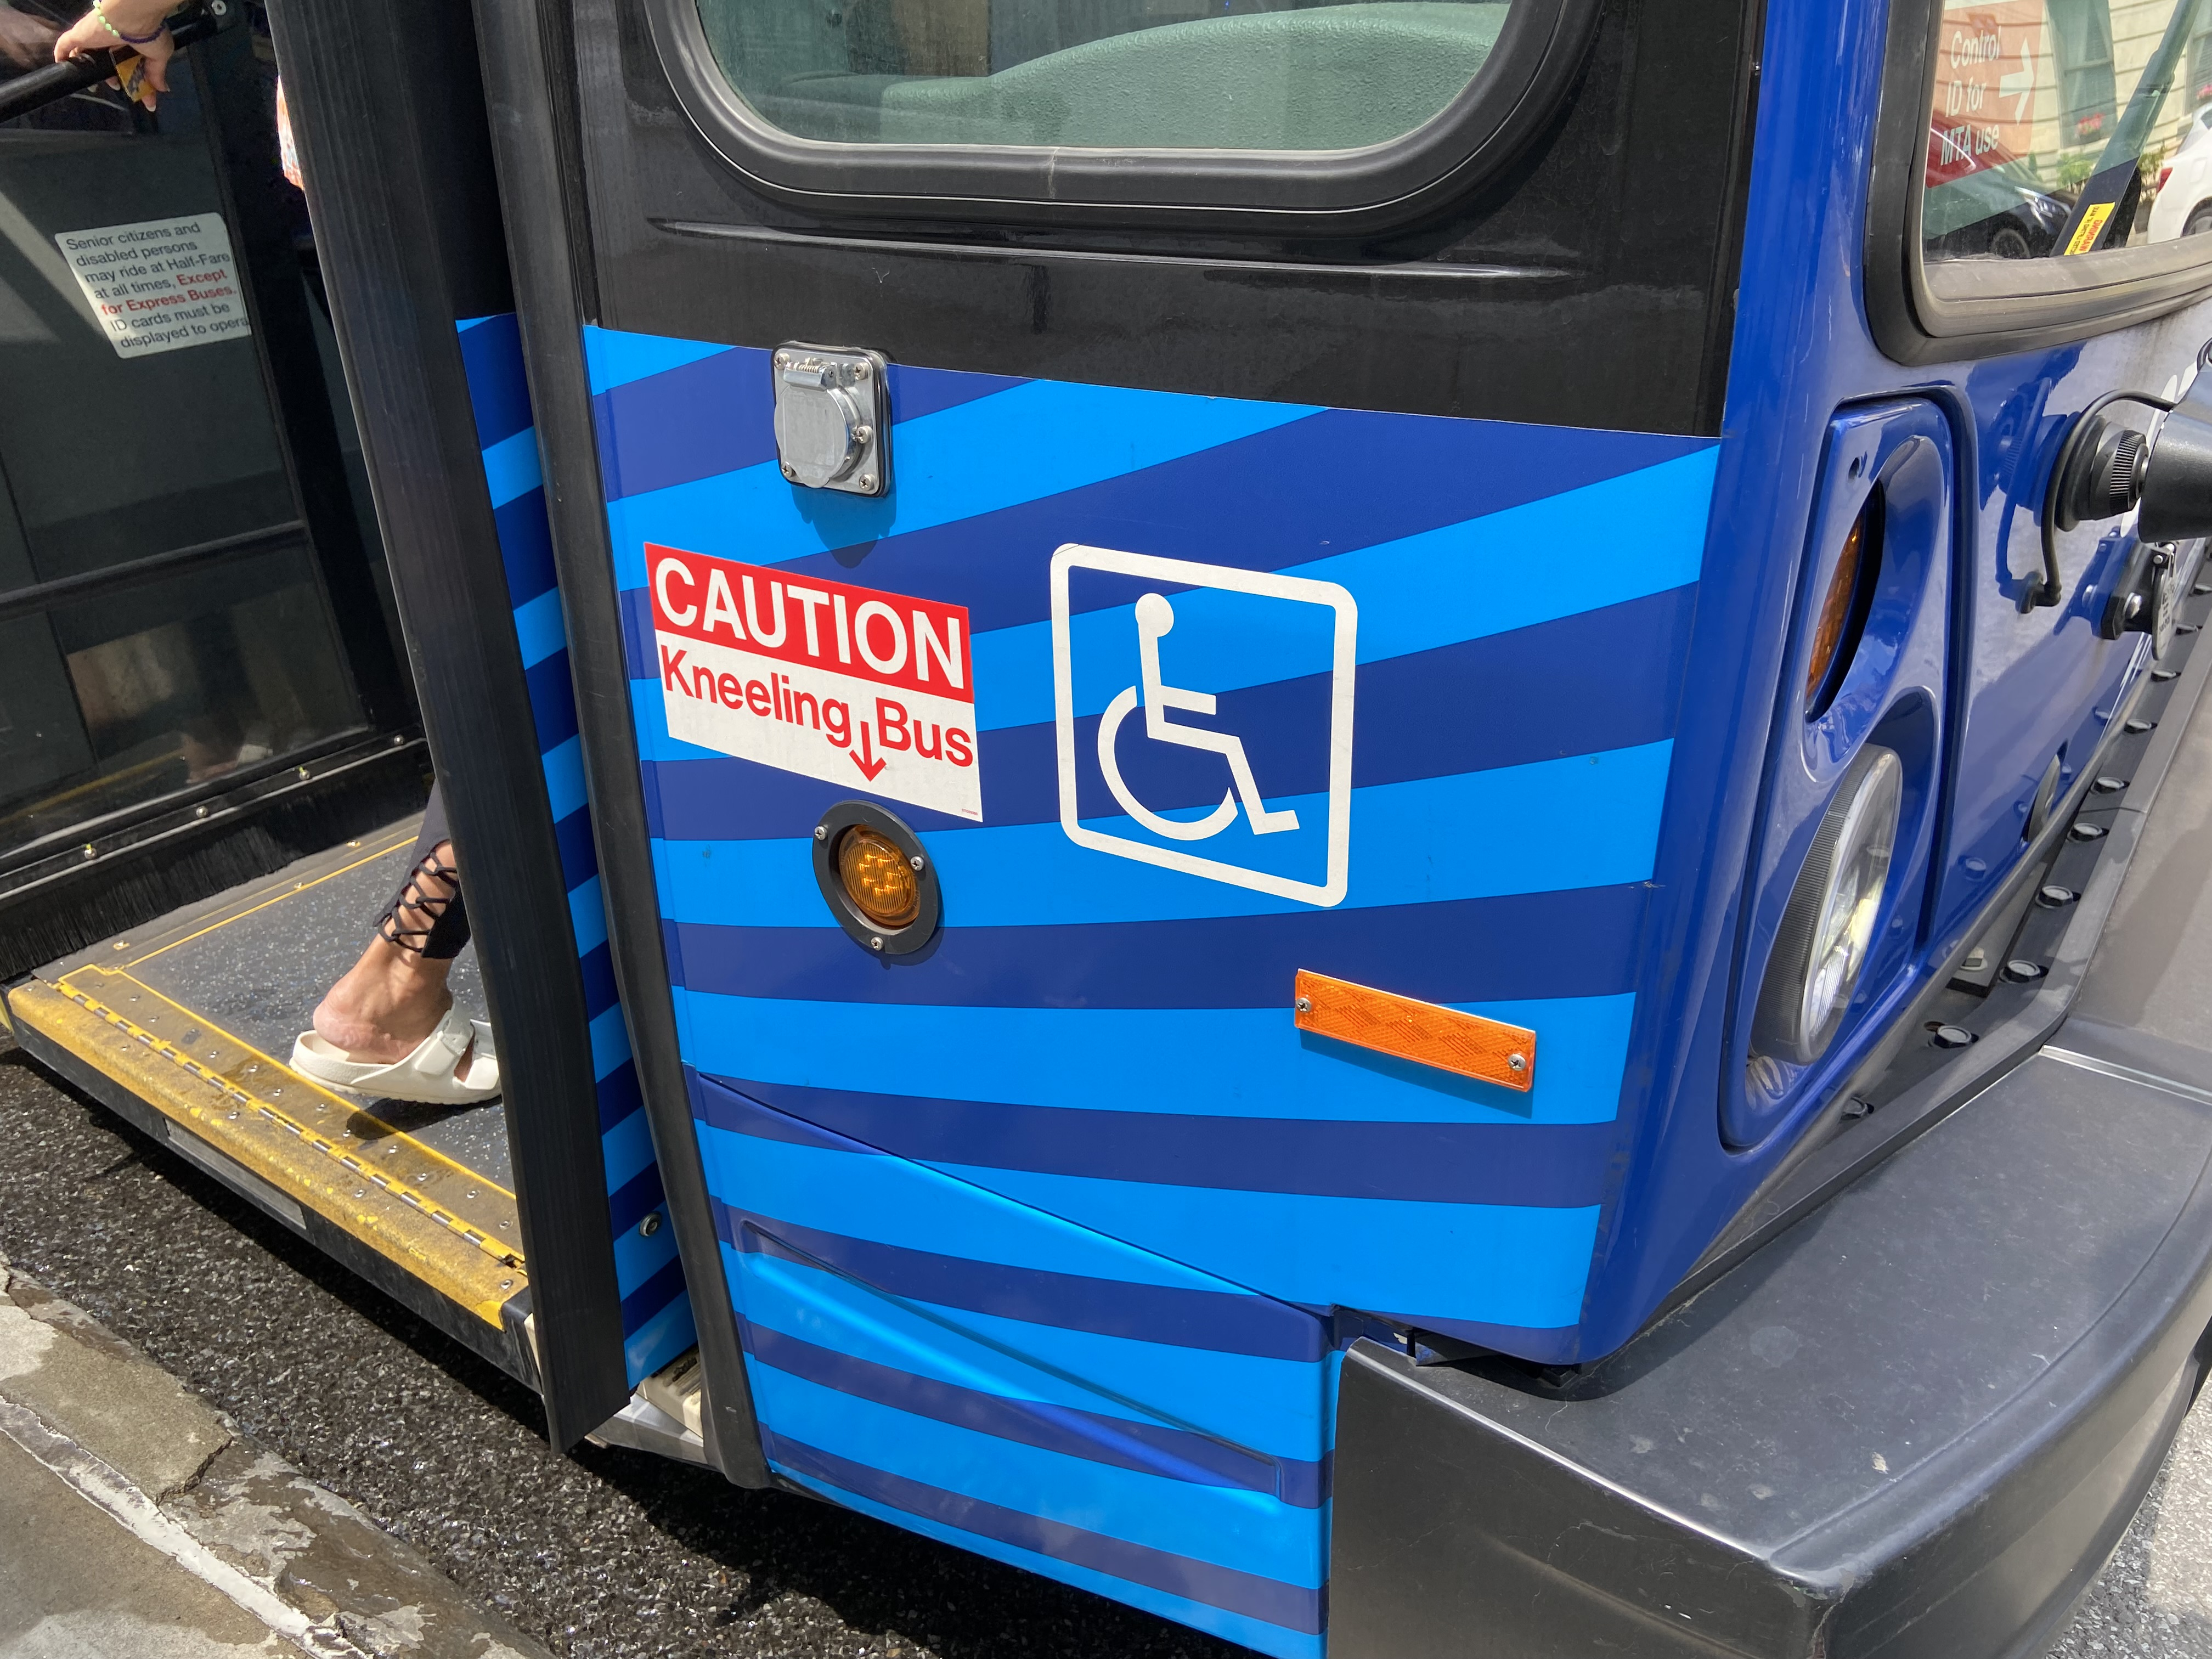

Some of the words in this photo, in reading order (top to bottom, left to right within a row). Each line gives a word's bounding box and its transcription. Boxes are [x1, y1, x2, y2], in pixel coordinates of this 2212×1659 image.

[1950, 26, 2001, 69] Control
[1945, 80, 1962, 117] ID
[1966, 76, 1987, 112] for
[1940, 125, 1971, 166] MTA
[1976, 125, 1999, 156] use
[66, 235, 114, 250] Senior
[118, 228, 171, 244] citizens
[174, 222, 201, 235] and
[76, 248, 138, 267] disabled
[141, 241, 198, 259] persons
[84, 270, 116, 283] may
[119, 263, 148, 278] ride
[150, 259, 165, 272] at
[166, 252, 230, 270] Half-Fare
[95, 287, 109, 299] at
[112, 283, 128, 296] all
[132, 278, 177, 294] times,
[176, 269, 227, 286] Except
[101, 303, 123, 315] for
[126, 294, 186, 313] Express
[187, 286, 237, 302] Buses.
[111, 319, 127, 332] ID
[131, 312, 172, 330] cards
[174, 304, 210, 320] must
[212, 302, 230, 314] be
[120, 326, 189, 348] displayed
[191, 323, 206, 335] to
[656, 557, 964, 690] CAUTION
[661, 645, 851, 748] Kneeling
[876, 697, 973, 768] Bus
